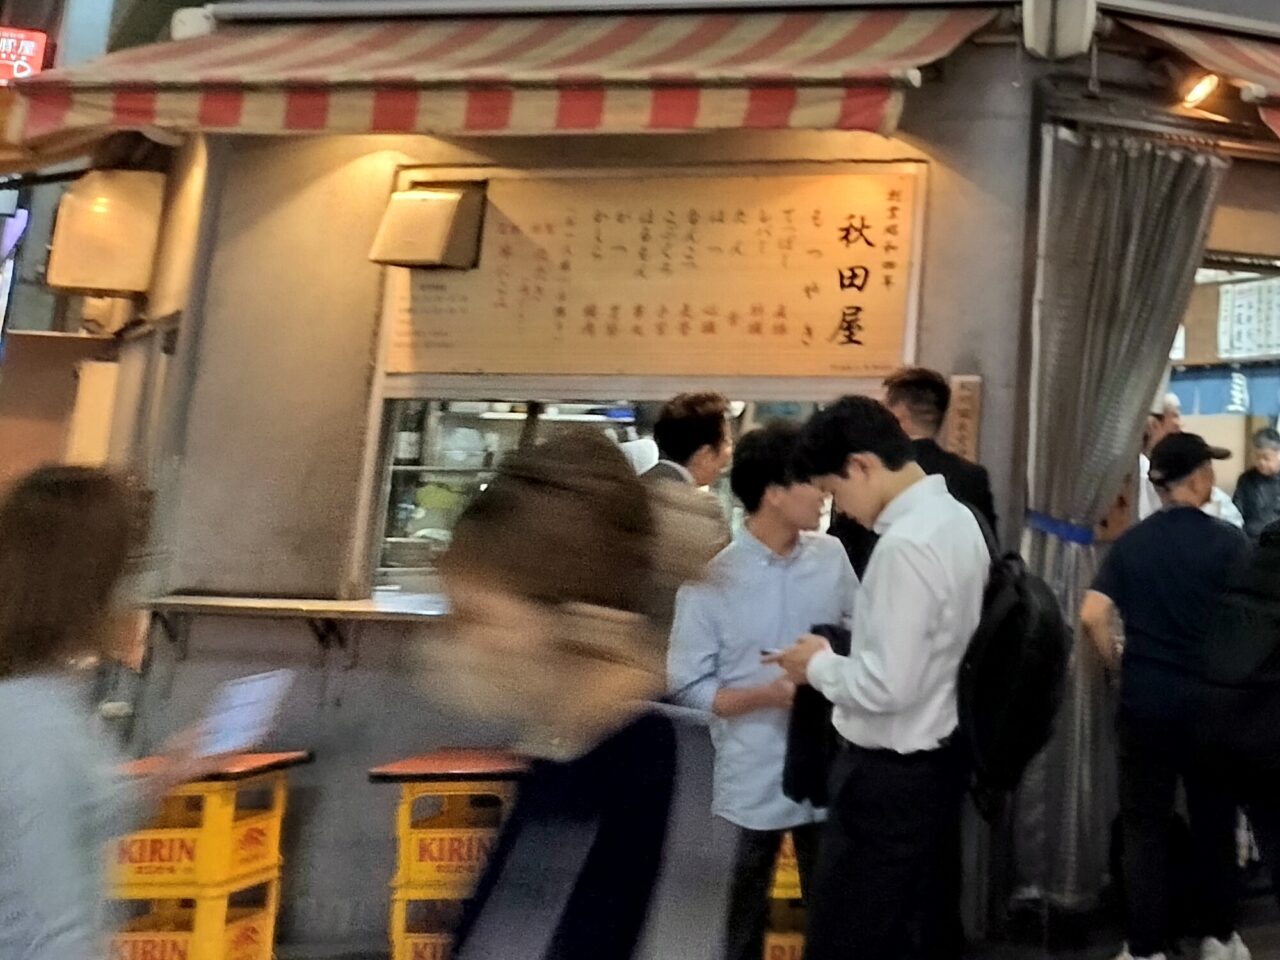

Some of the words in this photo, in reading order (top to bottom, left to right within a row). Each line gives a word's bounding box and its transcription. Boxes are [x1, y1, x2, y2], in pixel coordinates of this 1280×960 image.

[828, 214, 876, 347] 秋田屋
[118, 838, 195, 863] KIRIN
